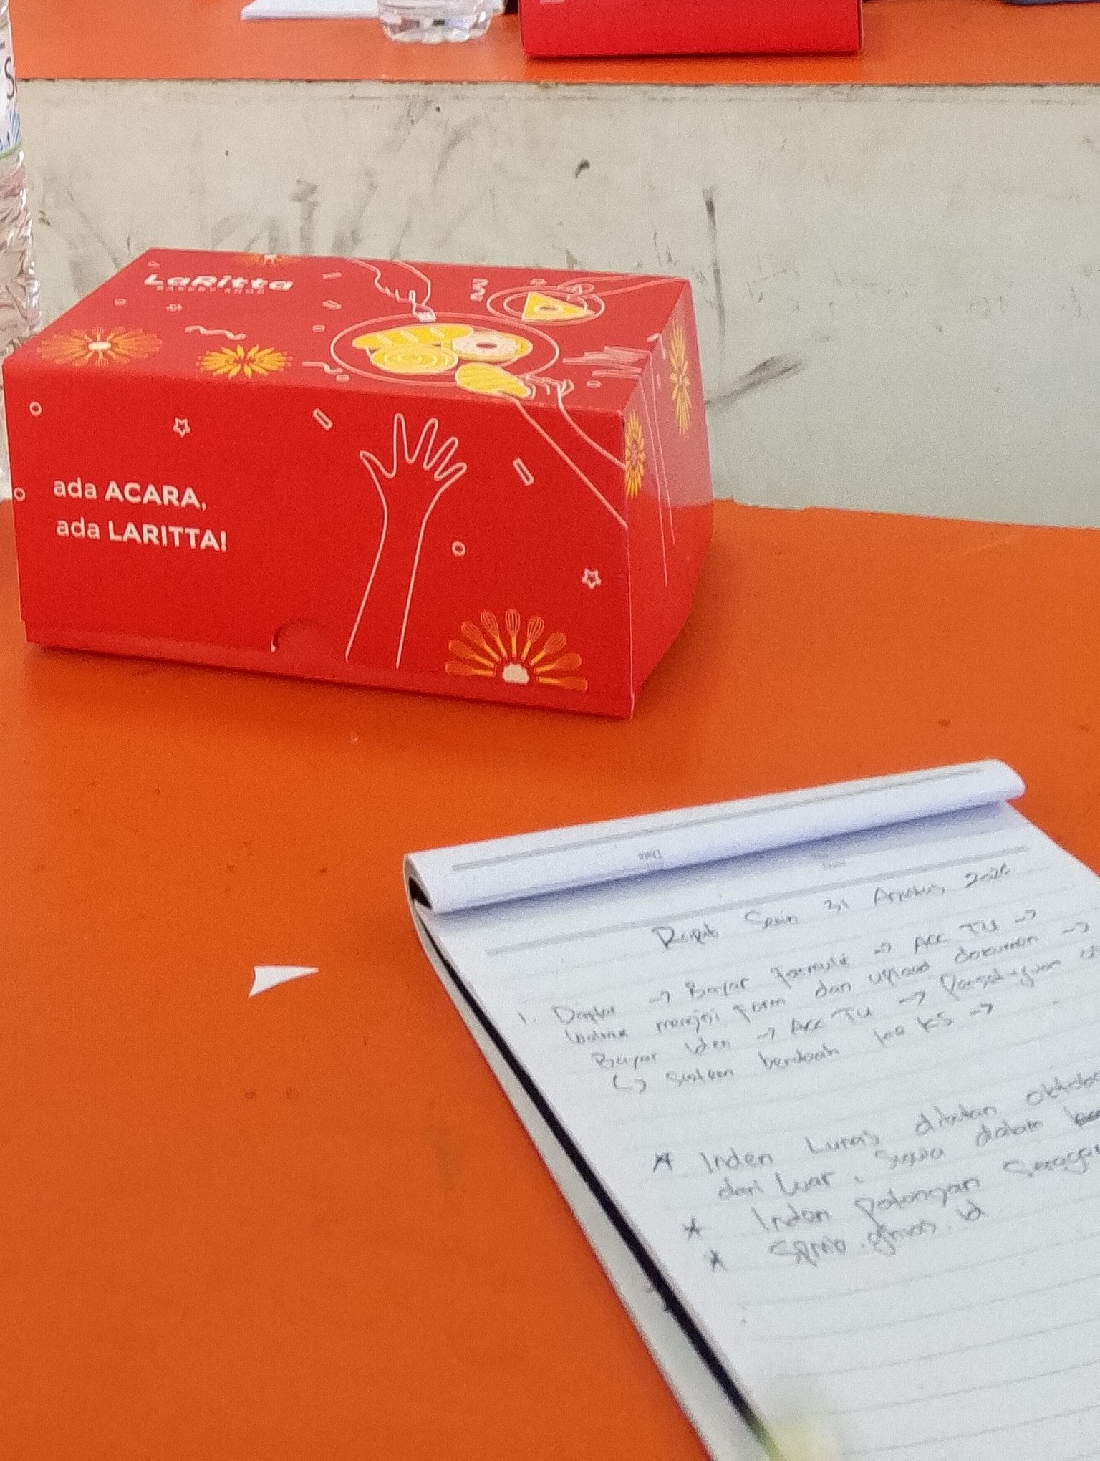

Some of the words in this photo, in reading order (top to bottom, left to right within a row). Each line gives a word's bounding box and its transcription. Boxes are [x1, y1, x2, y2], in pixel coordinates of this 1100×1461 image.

[142, 273, 295, 292] LaRitta
[52, 477, 99, 500] ada
[104, 481, 208, 511] ACARA,
[56, 517, 101, 541] ada
[107, 519, 228, 553] LARITTA!
